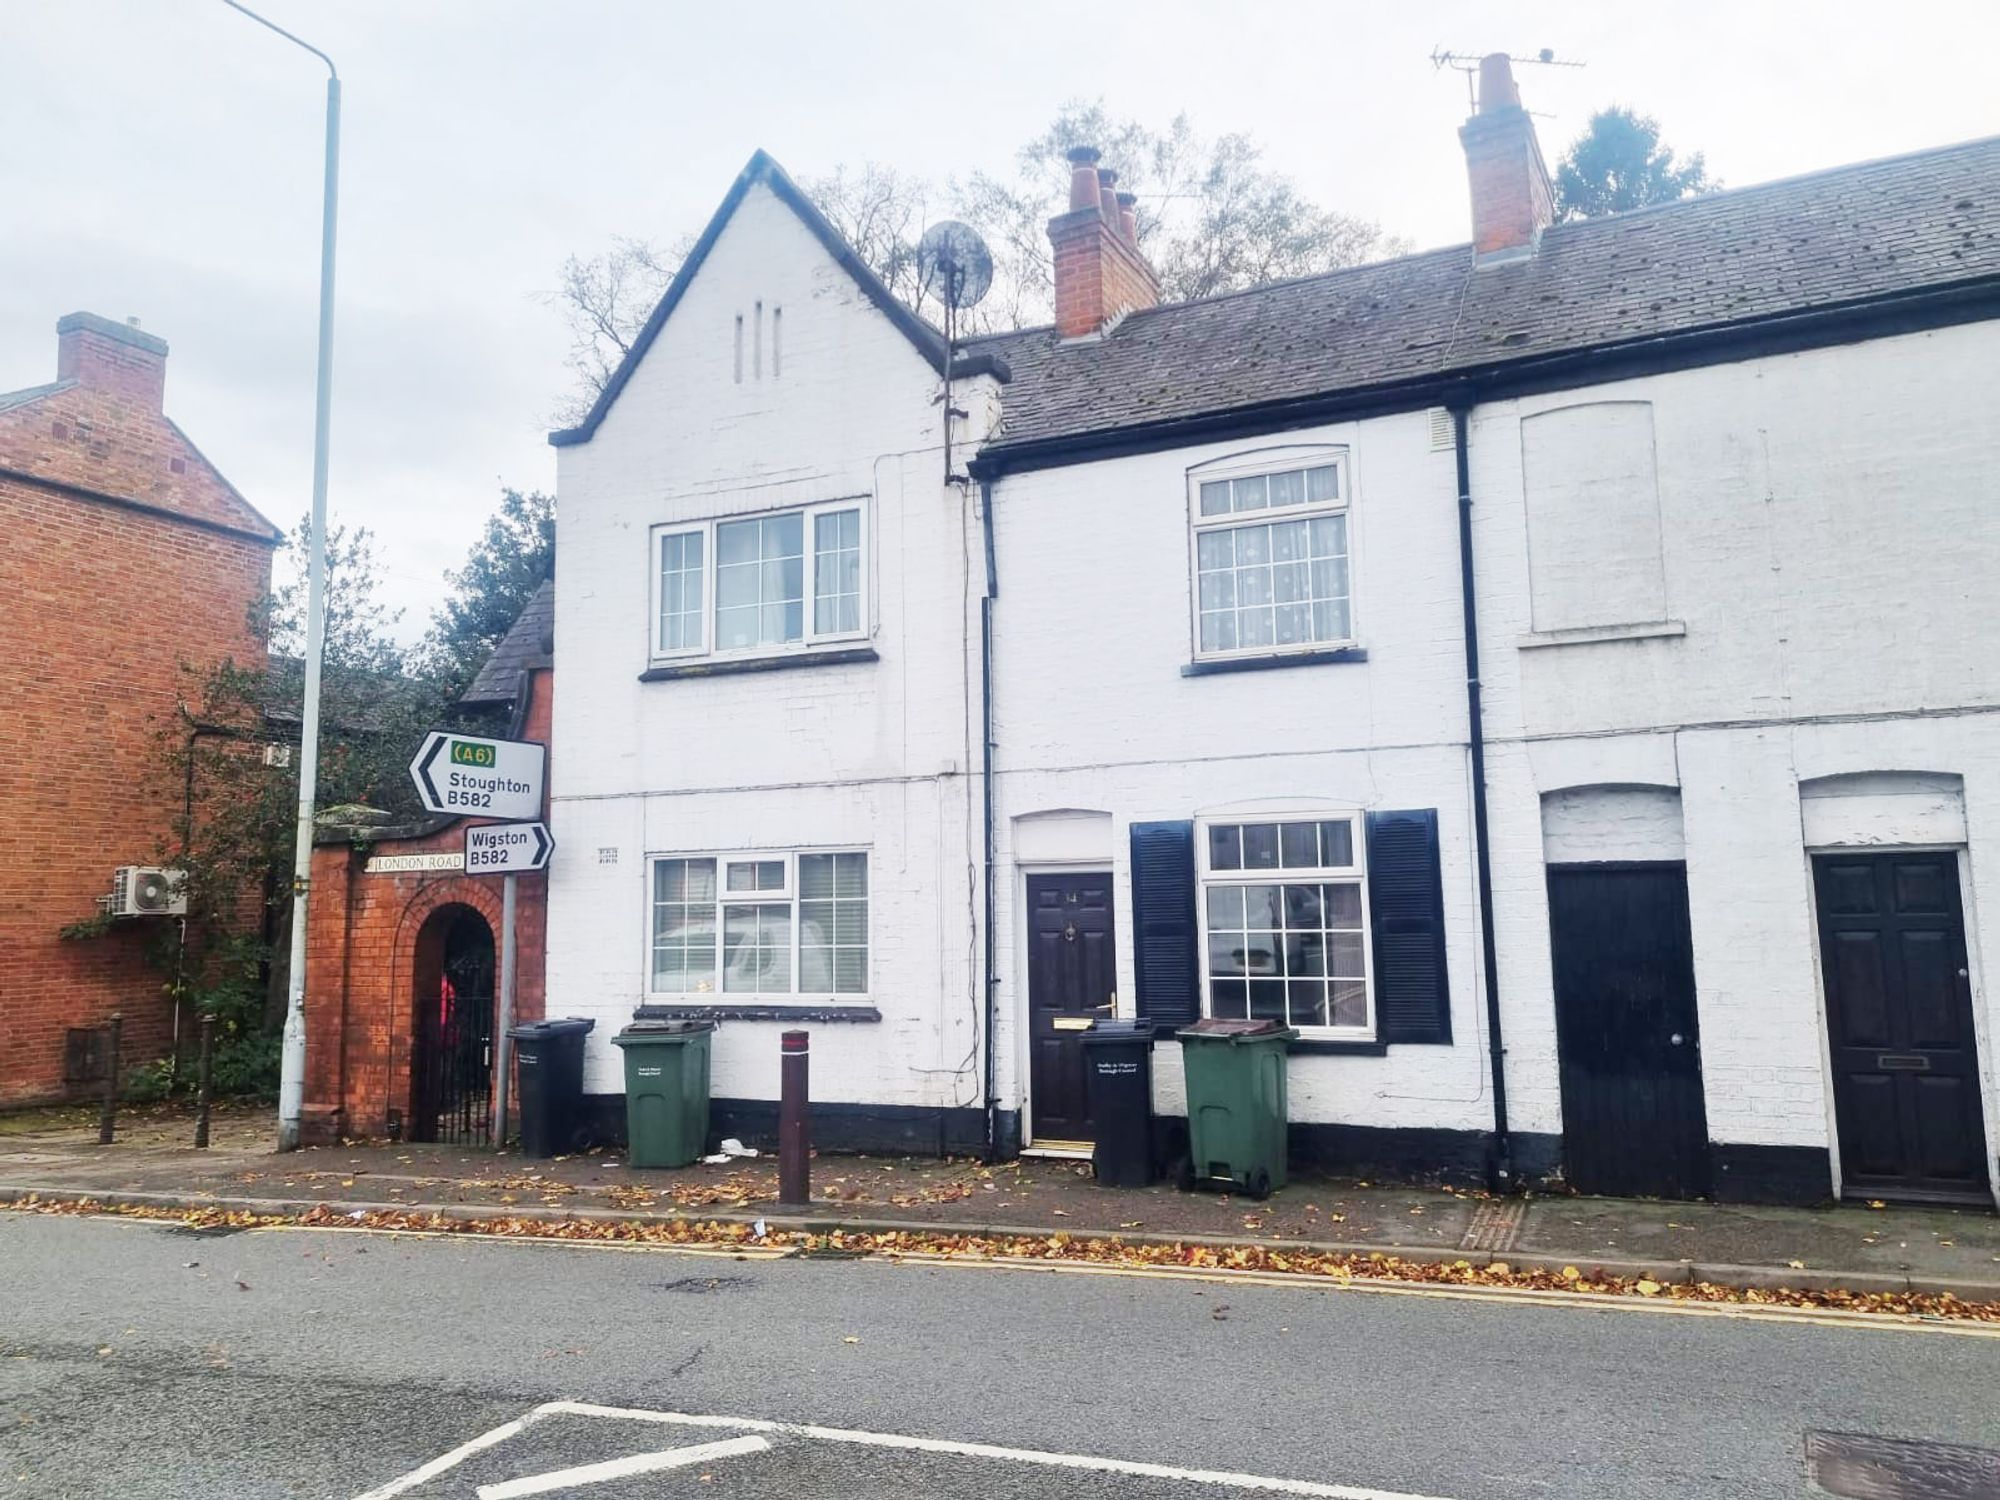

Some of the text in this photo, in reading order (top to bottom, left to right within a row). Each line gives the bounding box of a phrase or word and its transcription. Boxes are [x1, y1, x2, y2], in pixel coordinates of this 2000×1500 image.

[454, 744, 494, 763] (A6)
[450, 772, 530, 794] Stoughton
[448, 791, 491, 808] B582
[472, 833, 527, 848] Wigston
[378, 855, 461, 870] LONDON ROAD
[470, 850, 508, 865] B582
